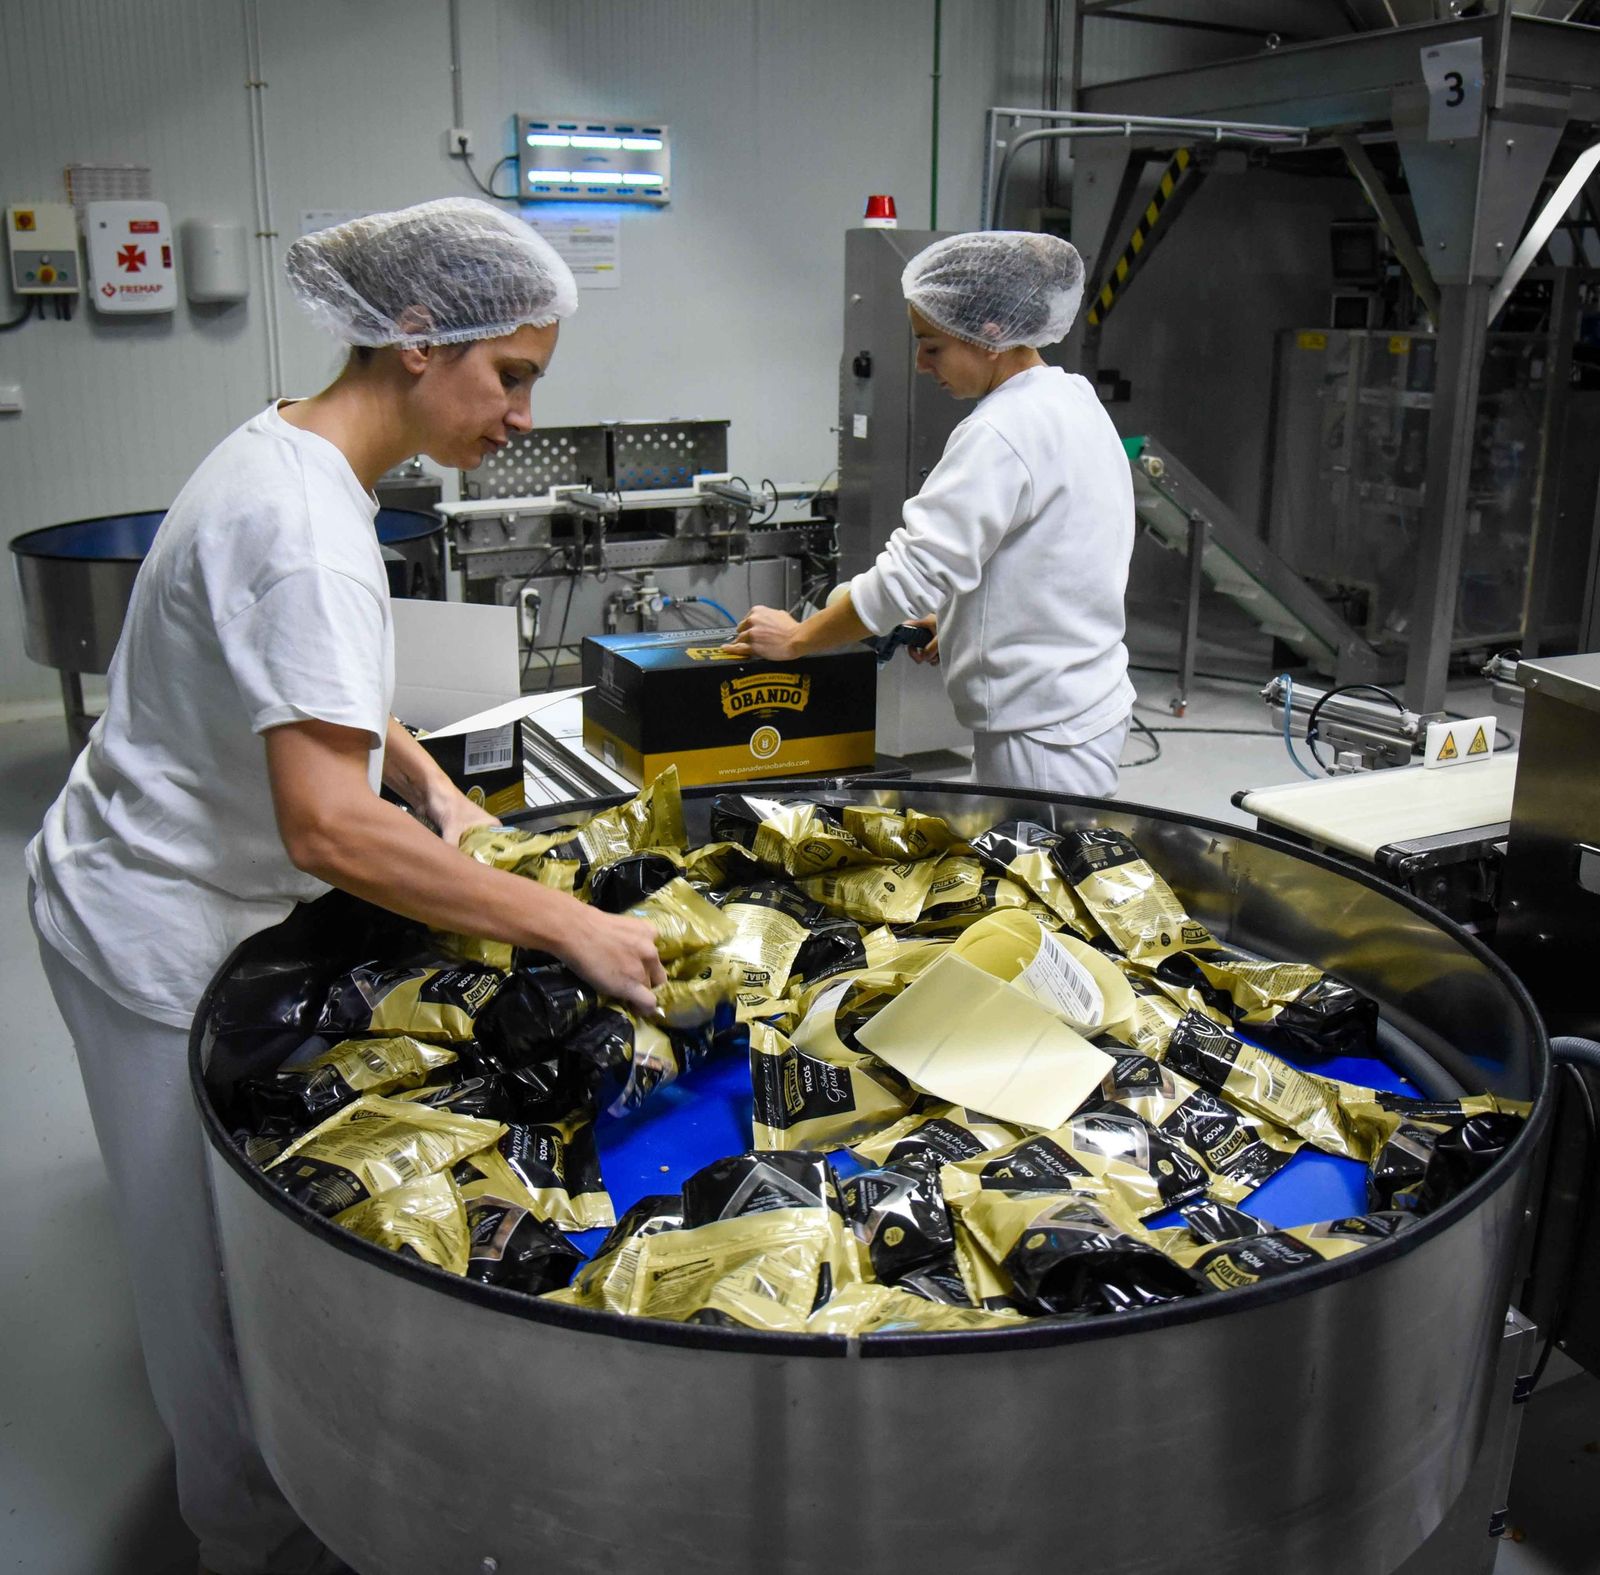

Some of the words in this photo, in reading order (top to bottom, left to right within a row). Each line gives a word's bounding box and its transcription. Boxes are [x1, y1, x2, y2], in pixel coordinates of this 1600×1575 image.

[1443, 71, 1465, 108] 3
[120, 284, 163, 294] FREMAP
[730, 687, 802, 711] OBANDO
[789, 1062, 801, 1108] OBANDO
[803, 1065, 813, 1093] PICOS
[825, 1065, 847, 1103] Gour
[1202, 1123, 1225, 1143] PICOS
[1209, 1130, 1242, 1161] OBANDO
[540, 1137, 548, 1161] PICOS
[1239, 1250, 1264, 1268] PICOS
